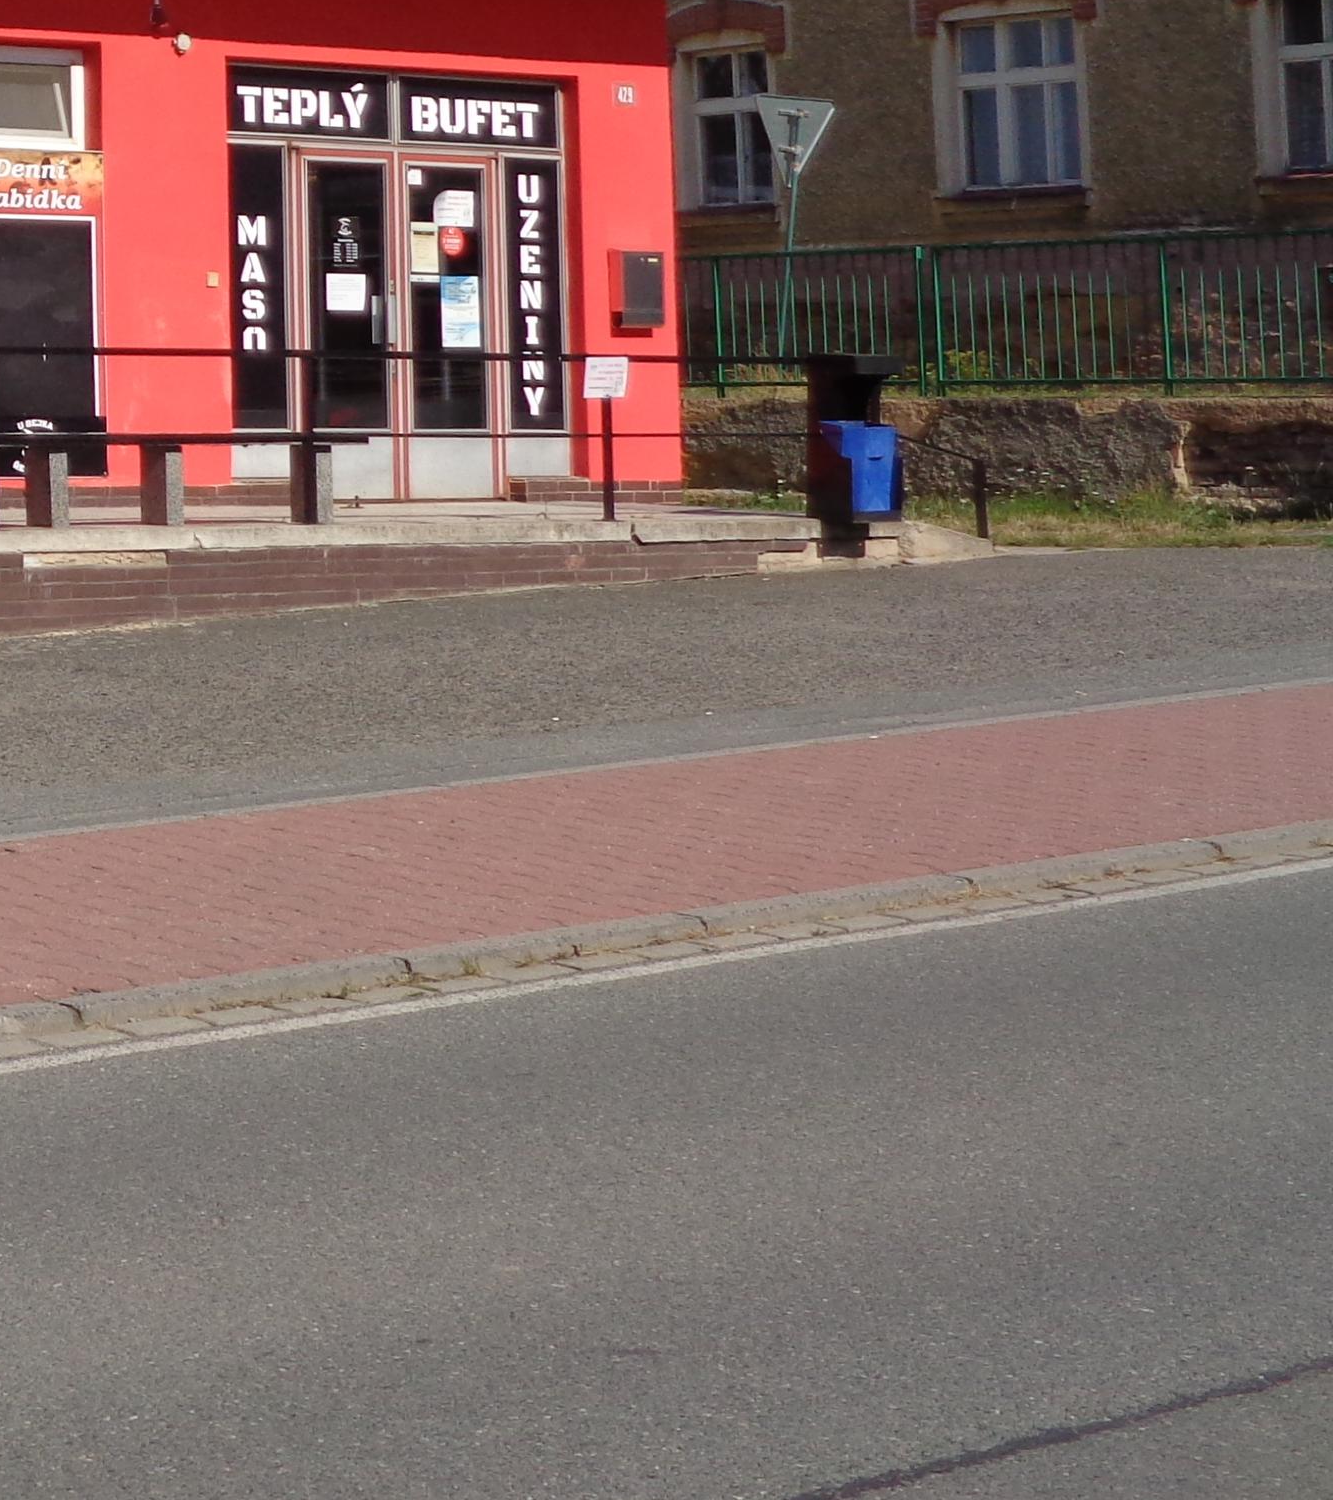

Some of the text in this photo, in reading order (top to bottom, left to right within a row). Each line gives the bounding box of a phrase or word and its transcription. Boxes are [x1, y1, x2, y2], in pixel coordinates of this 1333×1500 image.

[236, 83, 539, 138] TEPLÝ BUFET
[517, 174, 545, 416] UZENINY
